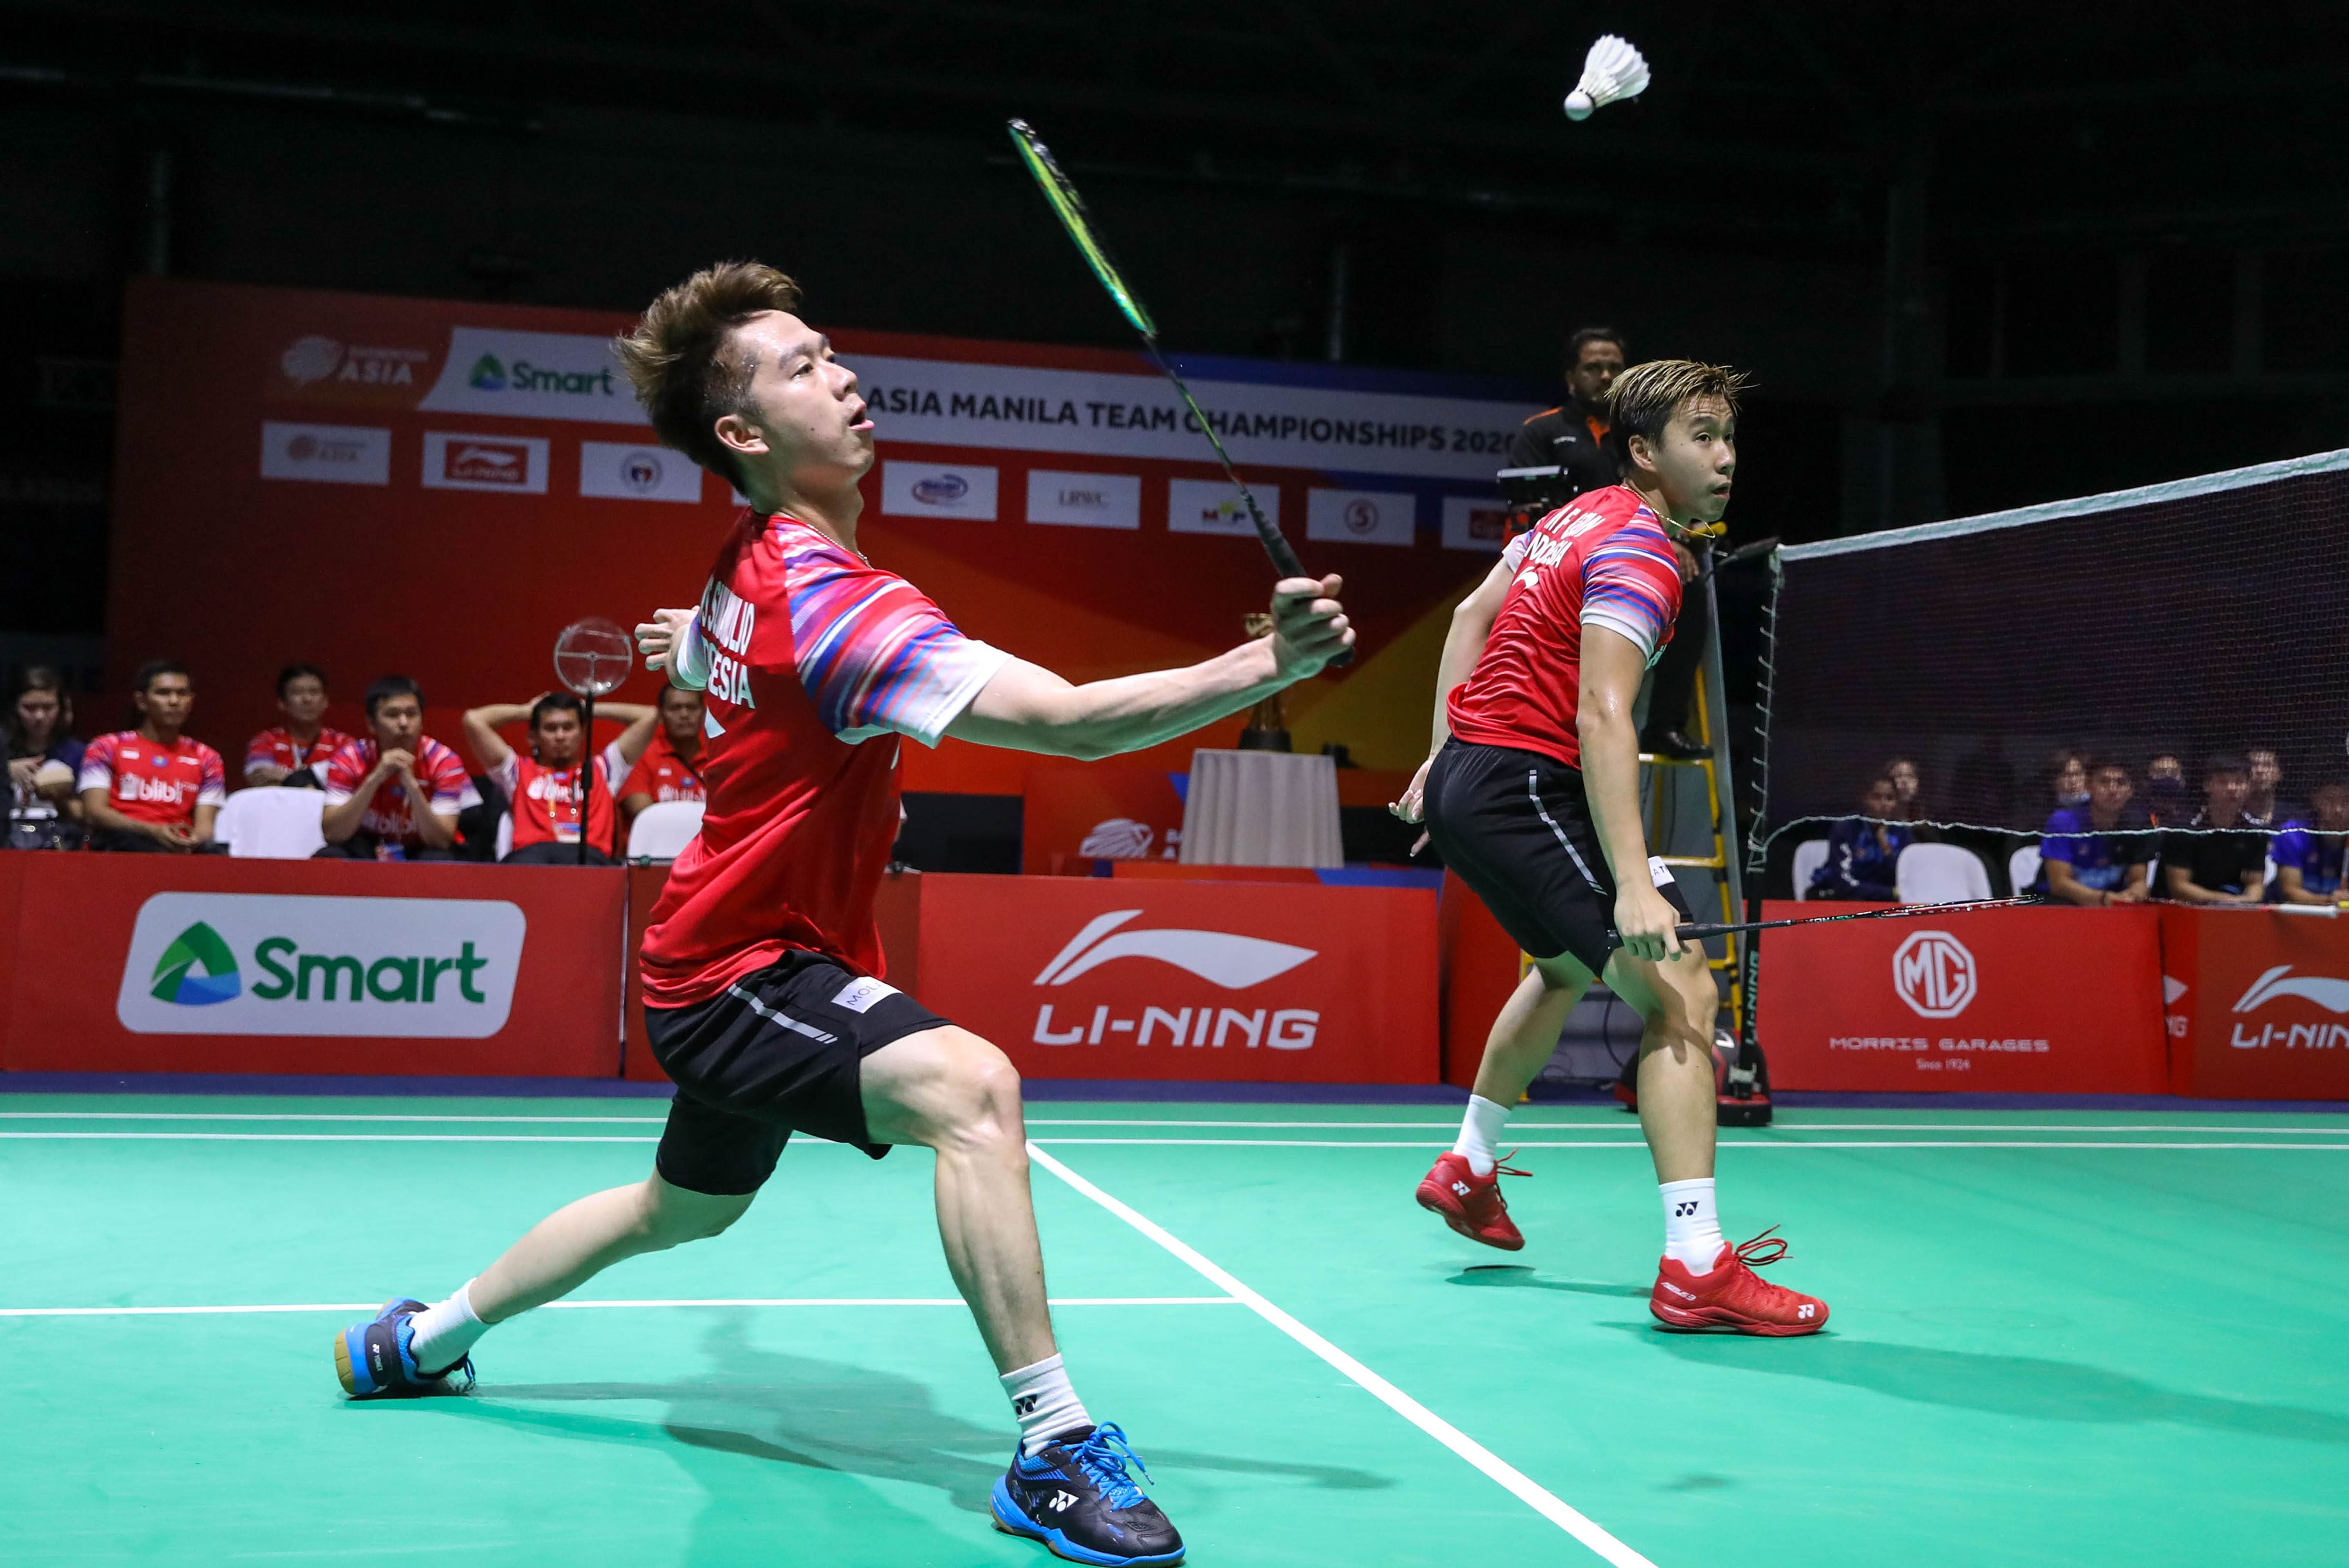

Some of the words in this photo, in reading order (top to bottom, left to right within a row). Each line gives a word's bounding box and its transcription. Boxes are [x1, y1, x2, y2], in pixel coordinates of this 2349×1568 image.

[339, 359, 412, 384] ASIA
[511, 362, 614, 396] Smart
[867, 386, 943, 417] ASIA
[951, 392, 1078, 427] MANILA
[1087, 401, 1175, 433] TEAM
[1183, 409, 1446, 451] CHAMPIONSHIPS
[251, 936, 489, 1004] Smart
[1903, 941, 1966, 1008] MG
[1032, 1004, 1320, 1050] LI-NING
[2231, 1022, 2349, 1049] LI-NIN
[1829, 1037, 1929, 1051] MORRIS
[1939, 1038, 2050, 1053] GARAGES
[1916, 1058, 1943, 1071] Since
